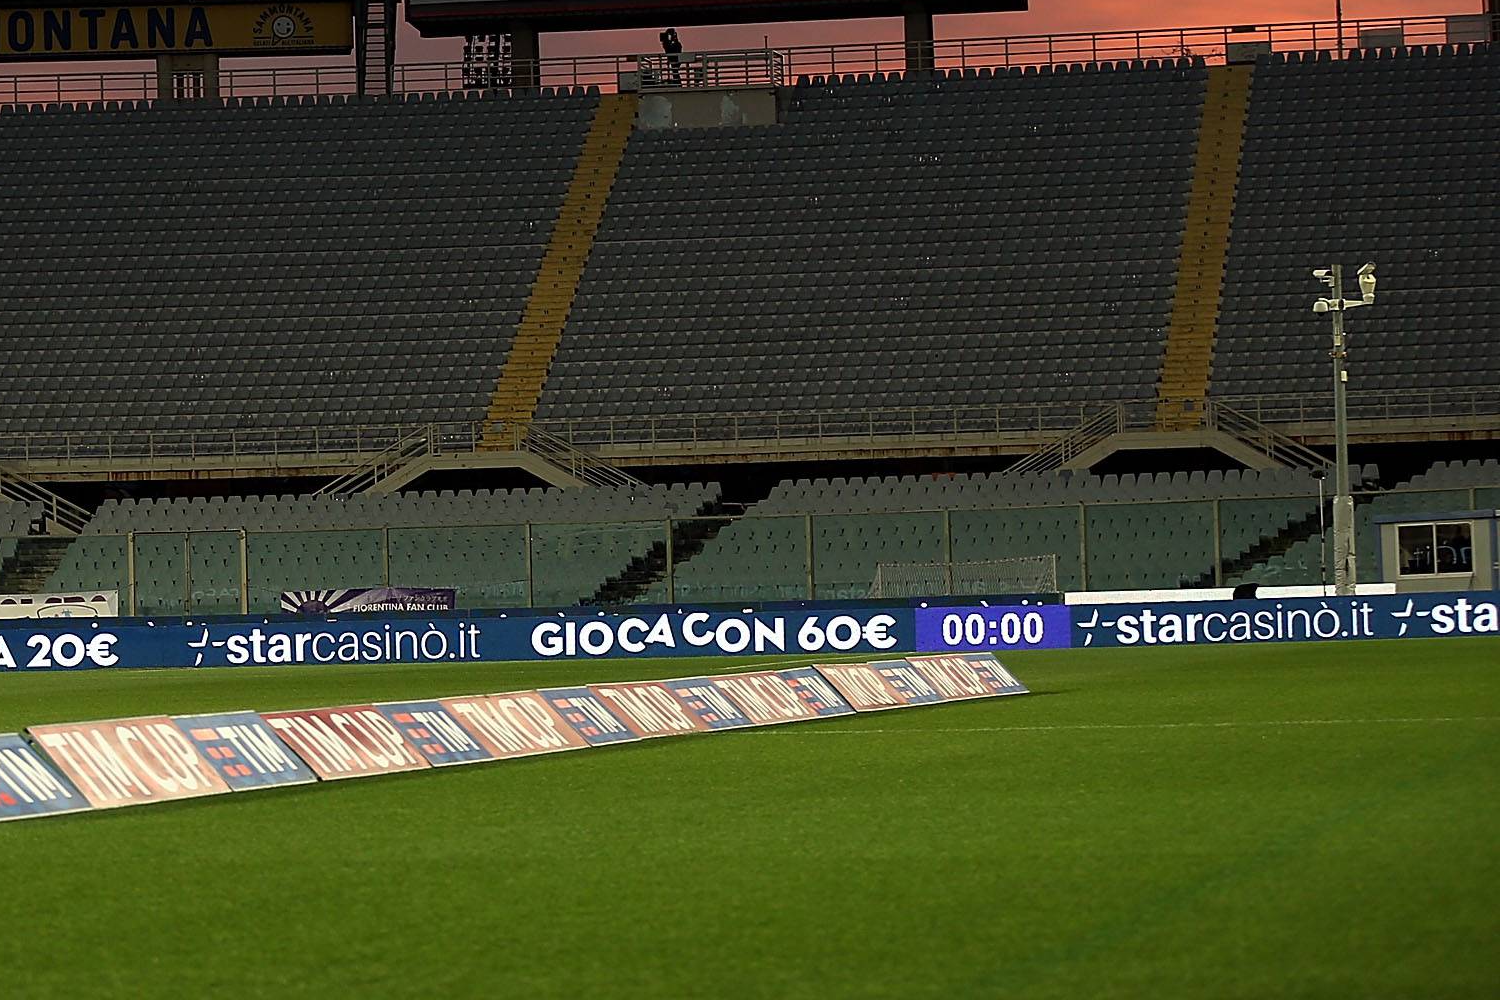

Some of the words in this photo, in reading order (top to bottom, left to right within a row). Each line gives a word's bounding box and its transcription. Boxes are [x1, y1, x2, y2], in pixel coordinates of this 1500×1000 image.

[252, 3, 314, 34] SAMMONTANA
[353, 603, 404, 612] FIORENTINA
[406, 603, 424, 611] FAN
[1116, 600, 1374, 645] starcasinò.it
[226, 622, 481, 664] starcasinò.it
[531, 613, 676, 656] GIOCA
[681, 612, 786, 652] CON
[797, 614, 898, 652] 60€
[942, 612, 1044, 646] 00:00
[26, 633, 119, 668] 20€
[797, 676, 845, 708] TIM
[891, 667, 936, 697] TIM
[912, 660, 966, 698] TIM
[942, 657, 989, 694] CUP
[980, 660, 1020, 687] TIM
[568, 697, 627, 734] TIM
[689, 686, 743, 720] TIM
[713, 679, 780, 721] TIM
[749, 675, 810, 718] CUP
[267, 715, 368, 773] TIM
[330, 710, 417, 768] CUP
[411, 711, 480, 753] TIM
[452, 701, 534, 753] TIM
[499, 697, 569, 748] CUP
[40, 729, 152, 799] TIM
[115, 723, 212, 792] CUP
[215, 723, 298, 774] TIM
